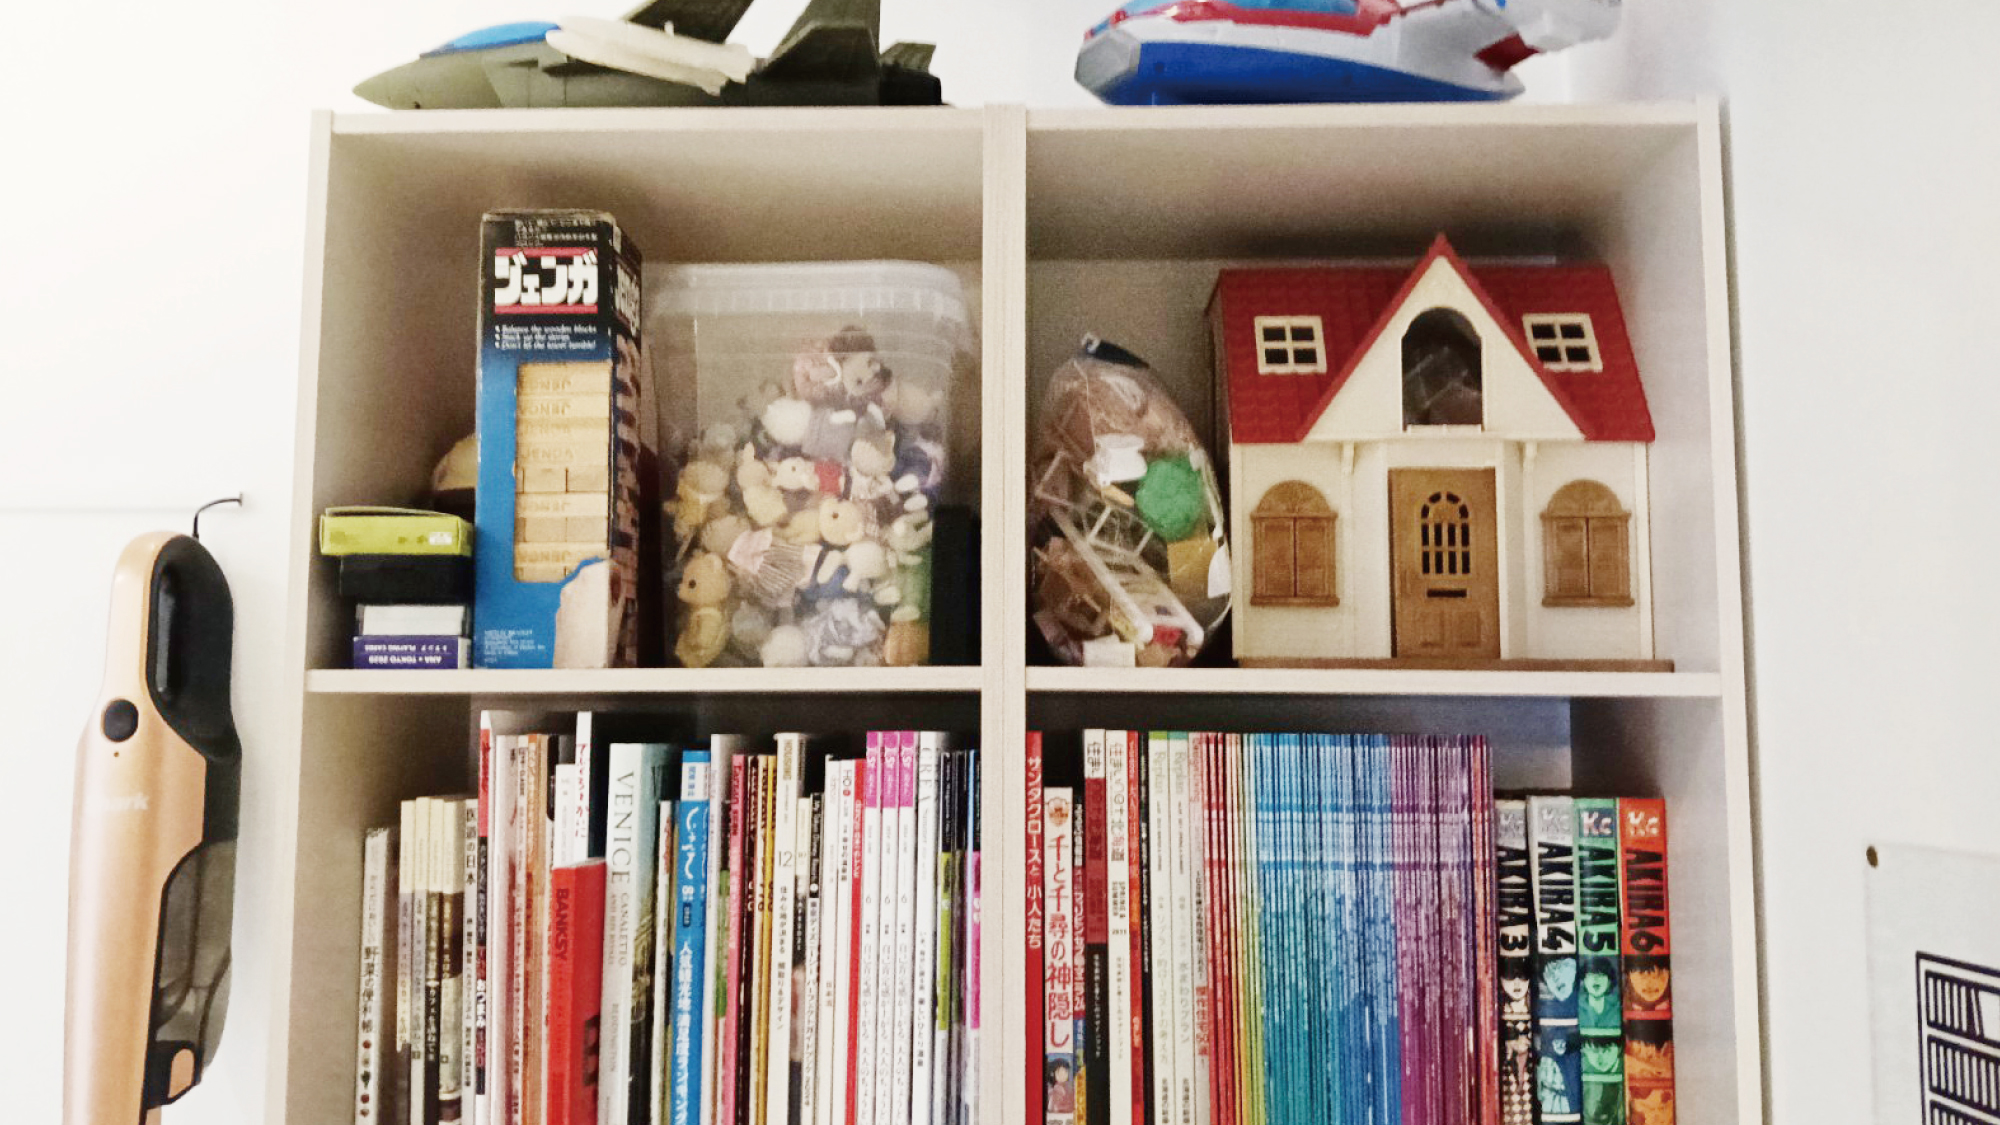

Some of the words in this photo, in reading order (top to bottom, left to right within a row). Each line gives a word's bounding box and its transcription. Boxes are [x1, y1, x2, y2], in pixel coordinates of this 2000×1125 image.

[495, 251, 599, 306] ジェンガ
[389, 655, 417, 664] TOKYO
[612, 771, 635, 885] VENICE
[1027, 756, 1042, 877] サンタクロースと
[778, 850, 793, 867] 12
[1498, 846, 1528, 926] AKIRA
[1538, 841, 1575, 925] AKIRA
[1578, 844, 1618, 927] AKIRA
[1626, 849, 1666, 930] AKIRA
[555, 888, 570, 961] BANKSY
[619, 892, 629, 967] CANALETTO
[1027, 885, 1042, 950] 小人たち
[1047, 833, 1072, 1048] 千と千尋の神隠し
[1500, 934, 1528, 952] 3
[1541, 925, 1575, 951] 4
[1582, 931, 1616, 952] 5
[1630, 931, 1665, 951] 6
